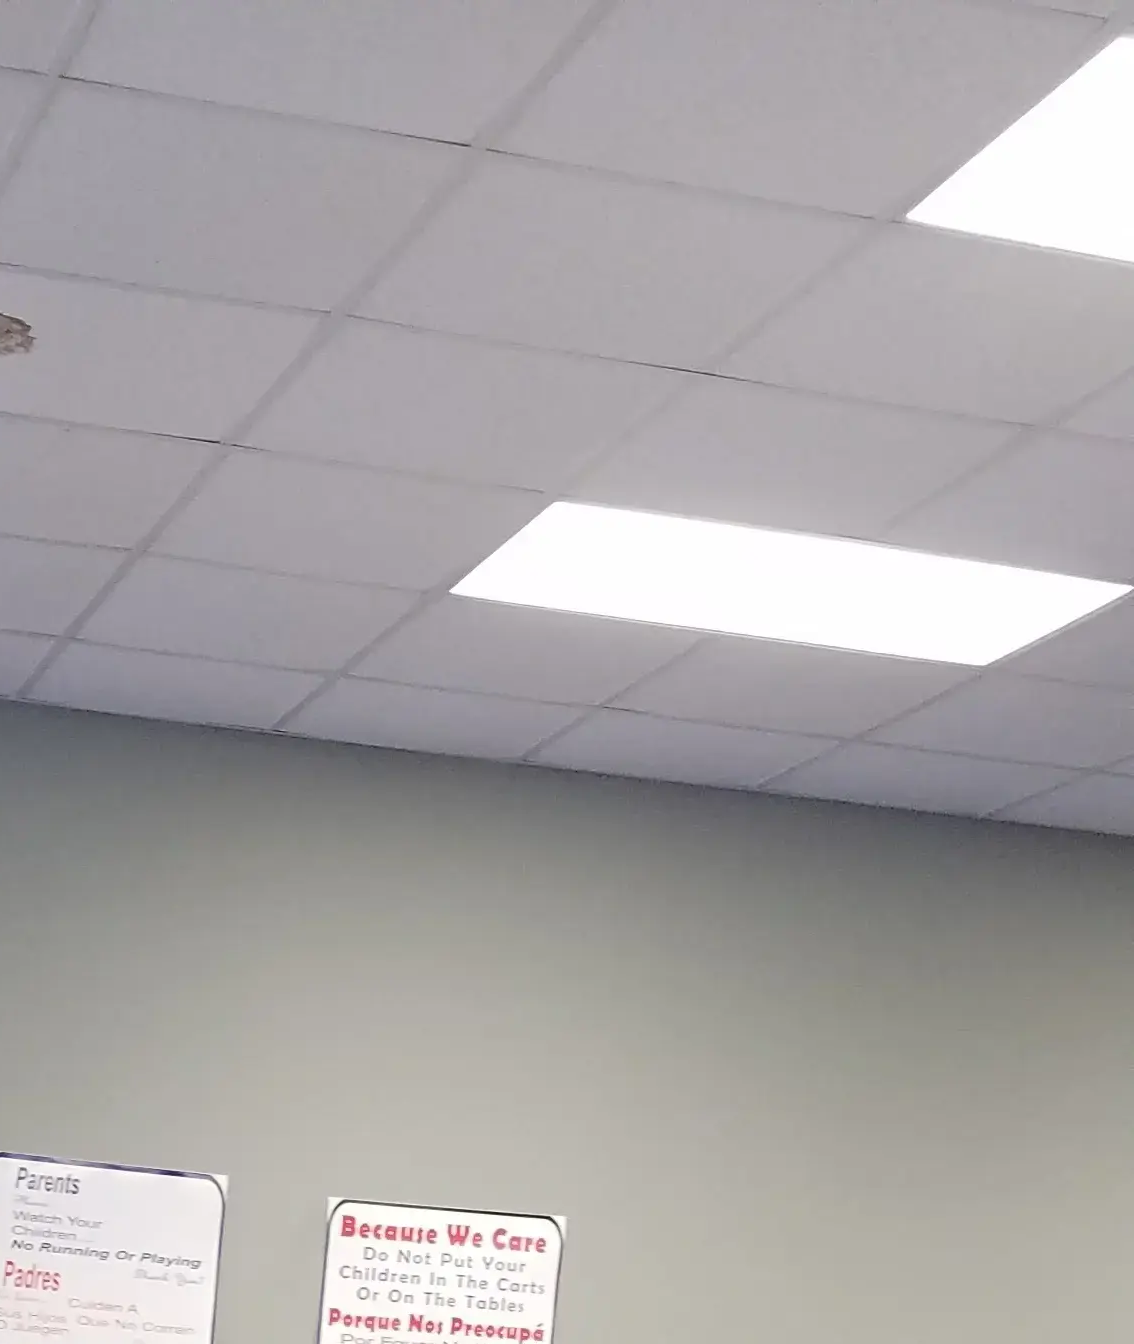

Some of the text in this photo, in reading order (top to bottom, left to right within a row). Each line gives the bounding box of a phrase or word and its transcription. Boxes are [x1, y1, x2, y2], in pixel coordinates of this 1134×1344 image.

[15, 1167, 81, 1195] Parents
[12, 1210, 103, 1229] Watch Your
[341, 1215, 547, 1253] Because We Care
[11, 1240, 202, 1270] No Running Or Playing
[362, 1247, 526, 1272] Do Not Put Your
[3, 1260, 61, 1291] Padres
[339, 1265, 545, 1295] Children In The Carts
[356, 1287, 524, 1313] Or On The Tables
[329, 1308, 401, 1333] Porque
[408, 1314, 443, 1334] Nos
[341, 1334, 374, 1344] Por
